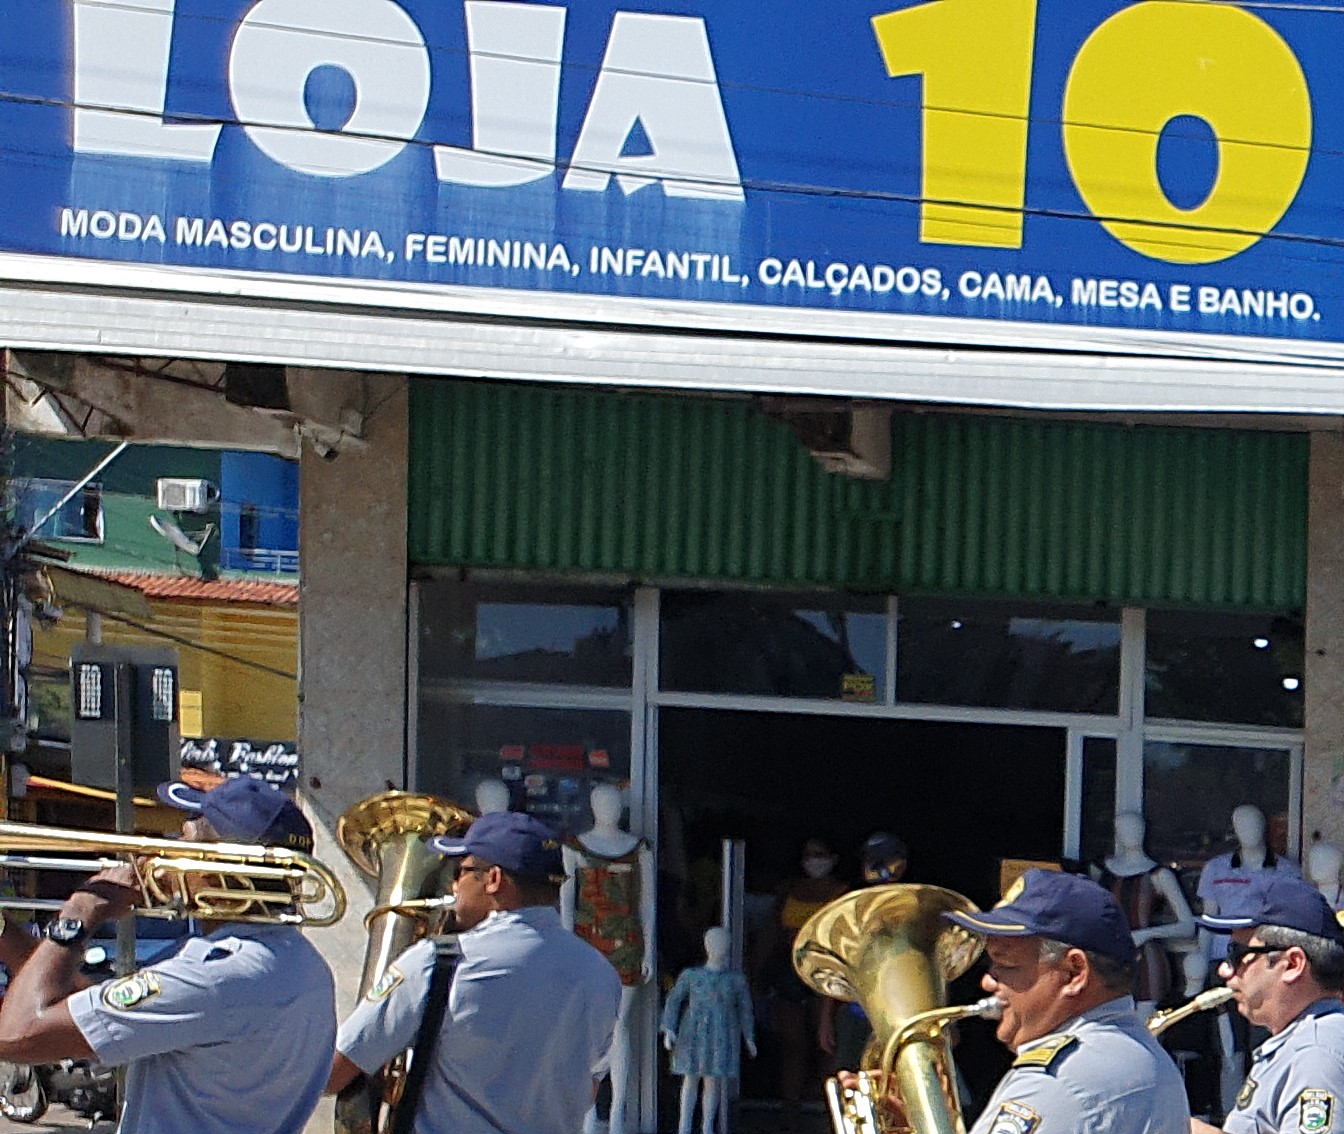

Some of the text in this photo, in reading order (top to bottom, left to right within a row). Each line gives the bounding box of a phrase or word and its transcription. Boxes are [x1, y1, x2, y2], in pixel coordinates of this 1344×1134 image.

[73, 0, 1312, 265] LOJA 10
[60, 208, 1322, 323] MODA MASCULINA, FEMININA, INFANTIL, CALÇADOS, CAMA, MESA E BANHO.
